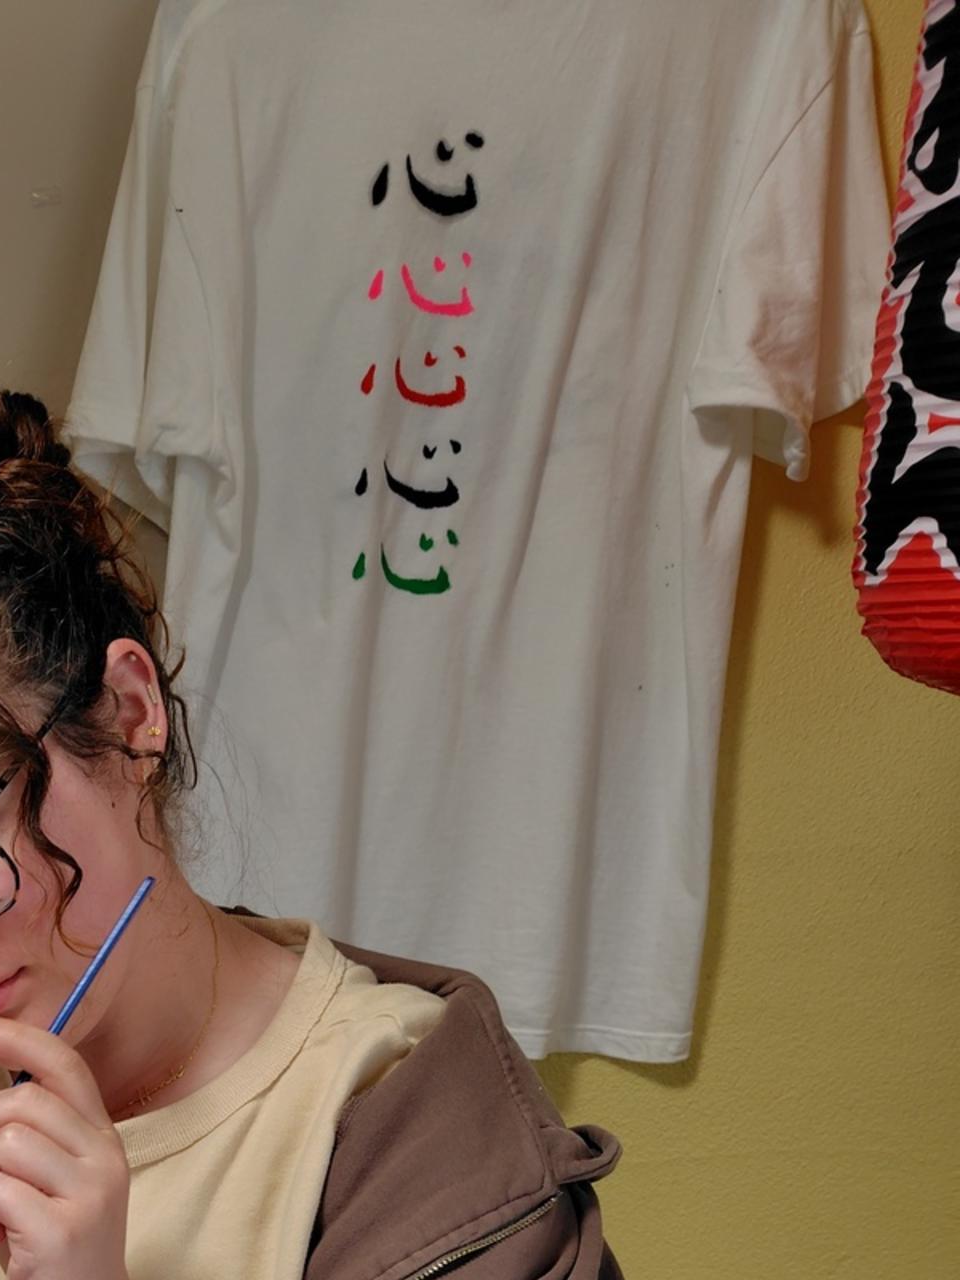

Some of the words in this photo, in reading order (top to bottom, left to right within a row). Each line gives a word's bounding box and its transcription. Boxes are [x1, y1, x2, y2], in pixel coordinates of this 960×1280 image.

[371, 131, 485, 218] 心
[367, 252, 474, 318] 心
[360, 345, 467, 408] 心
[354, 439, 462, 510] 心
[352, 529, 459, 595] 心
